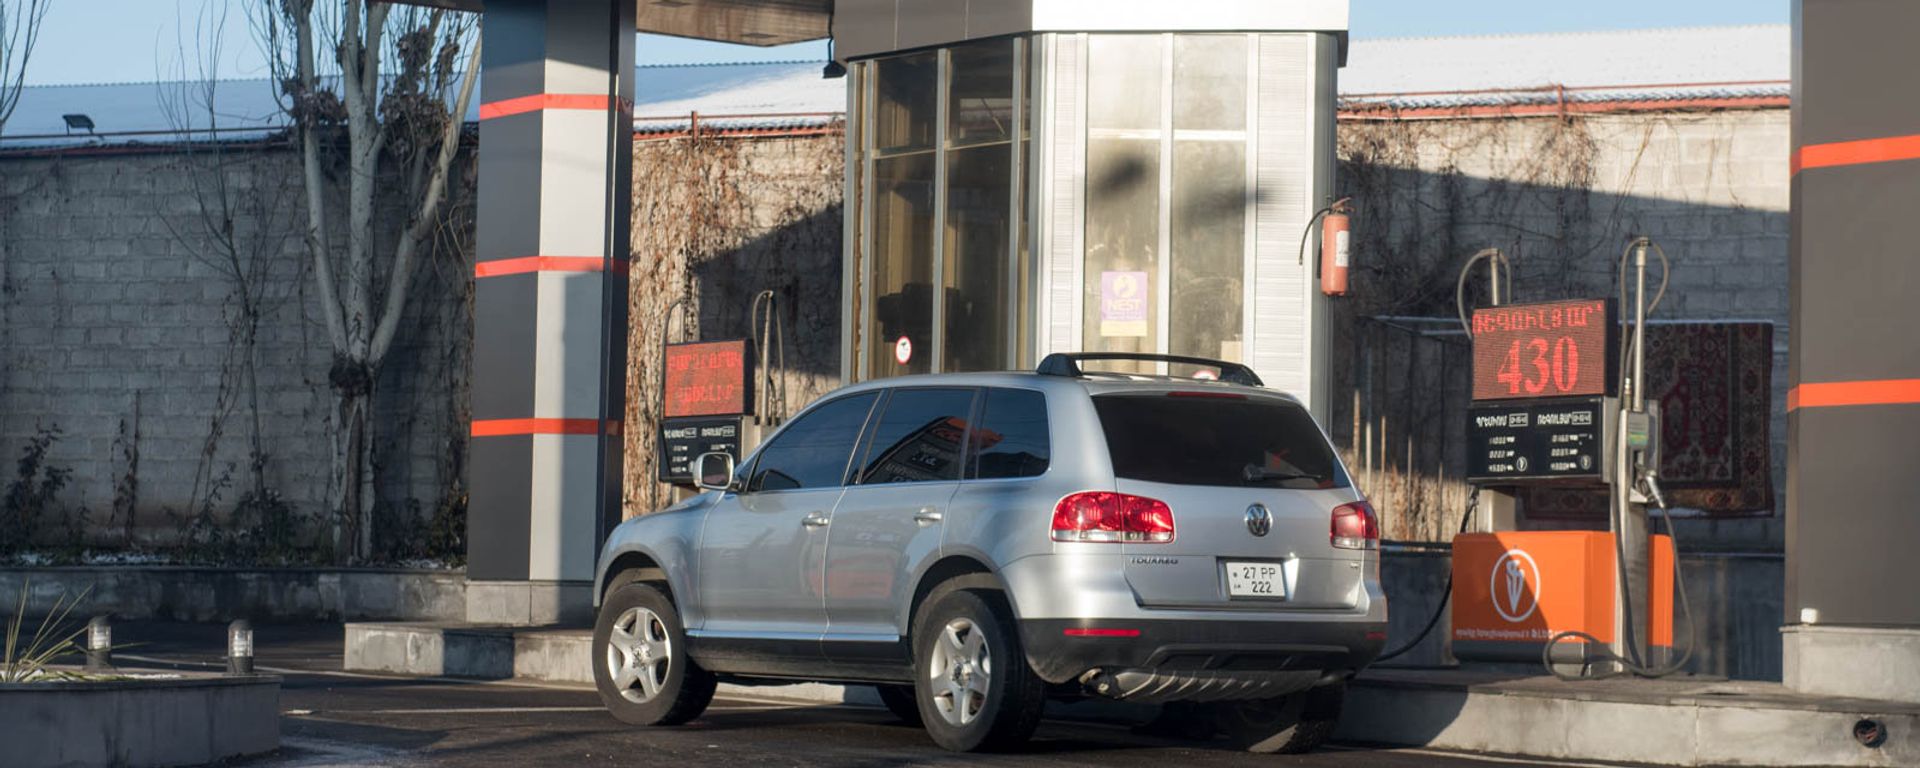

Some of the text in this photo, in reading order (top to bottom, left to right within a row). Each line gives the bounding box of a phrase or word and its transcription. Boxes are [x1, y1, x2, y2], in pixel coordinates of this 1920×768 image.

[1497, 336, 1578, 394] 430
[1243, 566, 1276, 580] 27 PP
[1251, 580, 1272, 594] 222
